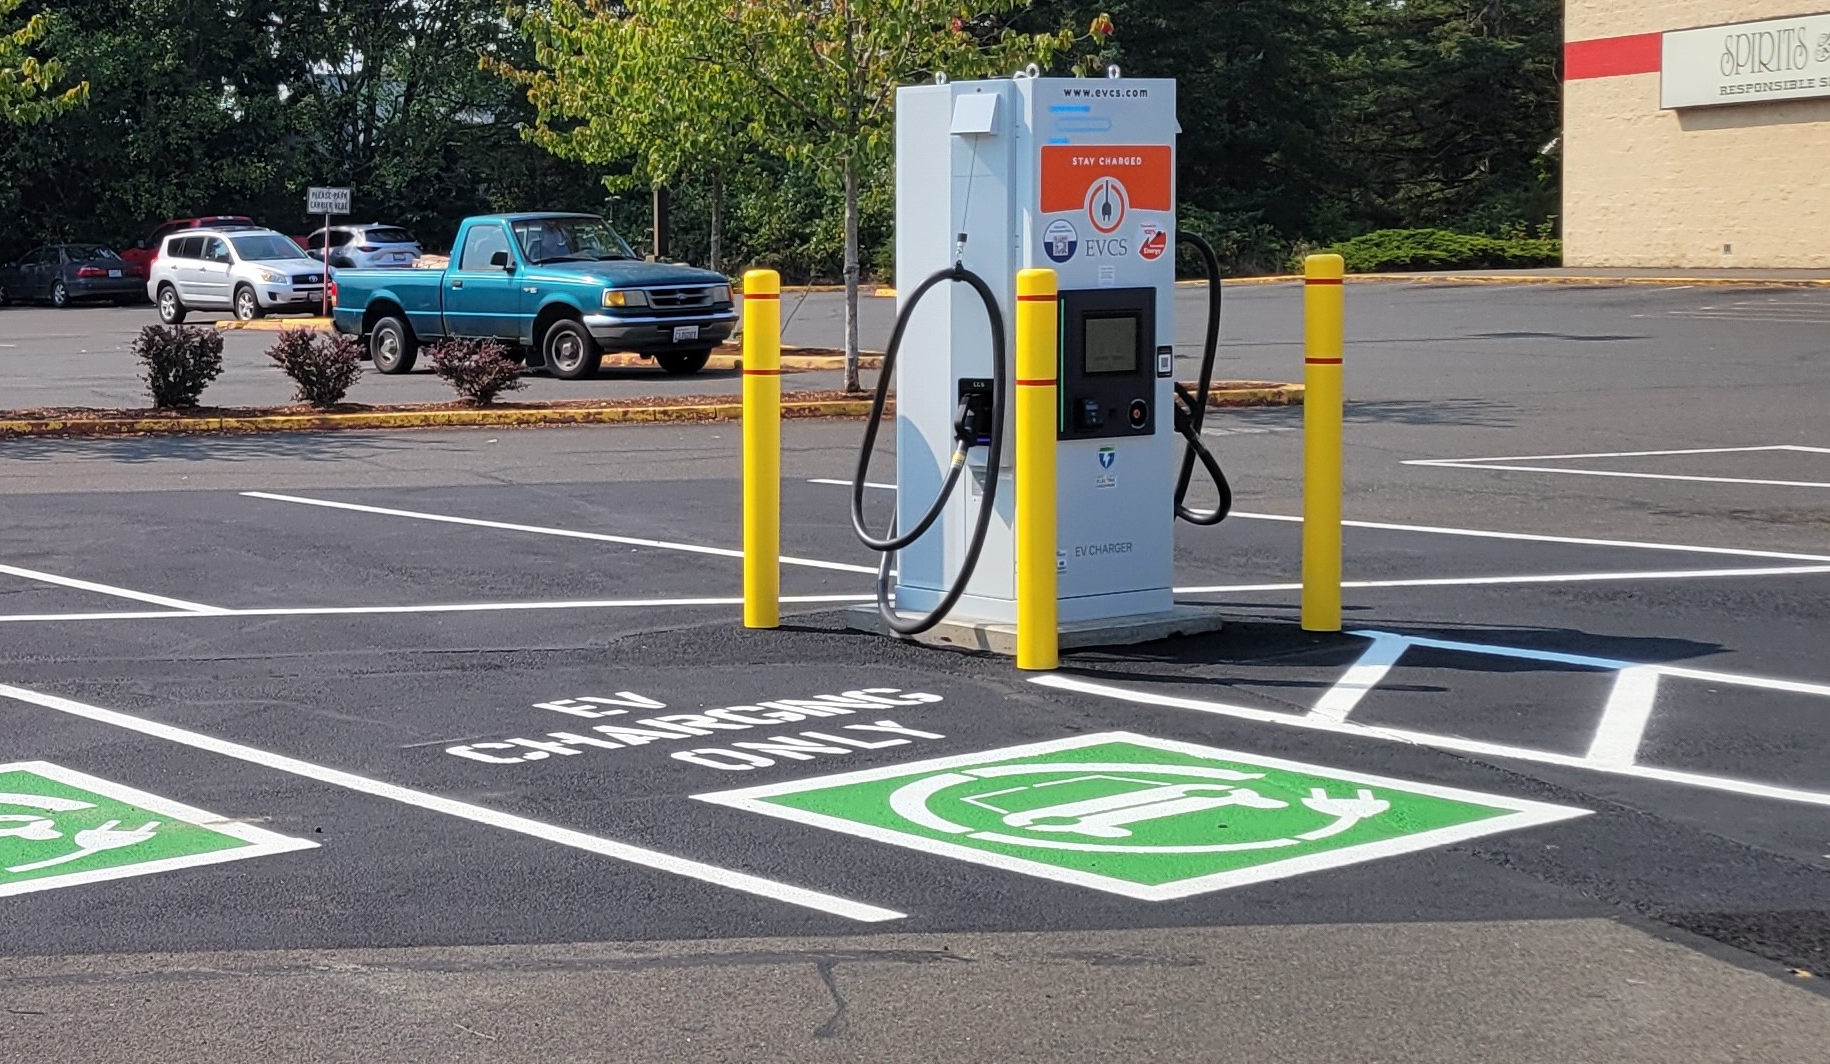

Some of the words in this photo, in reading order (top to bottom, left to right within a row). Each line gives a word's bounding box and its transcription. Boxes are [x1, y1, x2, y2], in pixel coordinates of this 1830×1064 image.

[1720, 26, 1808, 77] SPIRITS
[1063, 88, 1148, 98] www.evcs.com
[1719, 78, 1816, 96] RESPONSIBLE
[1072, 156, 1095, 166] STAY
[1098, 156, 1142, 166] CHARGED
[1085, 238, 1128, 257] EVCS
[1075, 546, 1087, 557] EV
[1088, 542, 1133, 556] CHARGER
[532, 691, 667, 718] EV
[445, 688, 945, 764] CHARGING
[670, 720, 946, 771] ONLY
